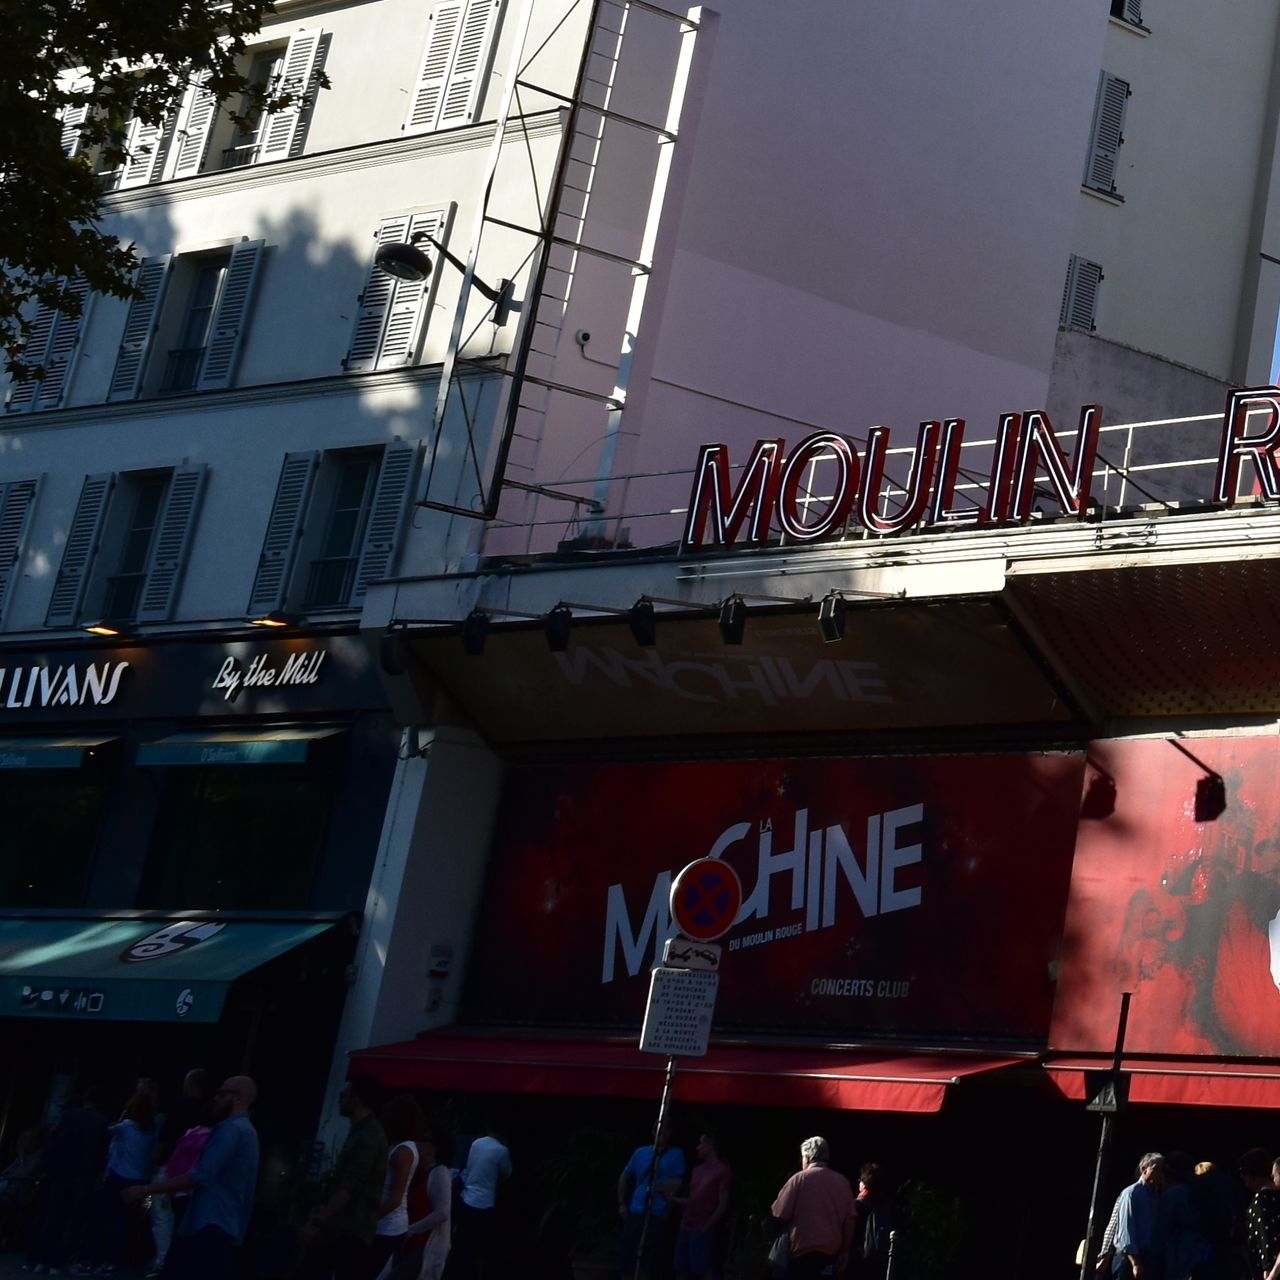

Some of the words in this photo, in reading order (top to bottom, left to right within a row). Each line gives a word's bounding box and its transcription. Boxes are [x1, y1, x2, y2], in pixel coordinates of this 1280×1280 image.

[682, 404, 1103, 554] MOULIN
[212, 654, 242, 702] By
[242, 653, 275, 689] the
[274, 649, 328, 686] Mill
[759, 817, 774, 834] LA
[602, 802, 925, 985] MCHINE
[728, 937, 741, 952] DU
[742, 929, 774, 949] MOULIN
[774, 922, 803, 941] ROUGE
[810, 976, 875, 998] CONCERTS
[877, 978, 911, 999] CLUB
